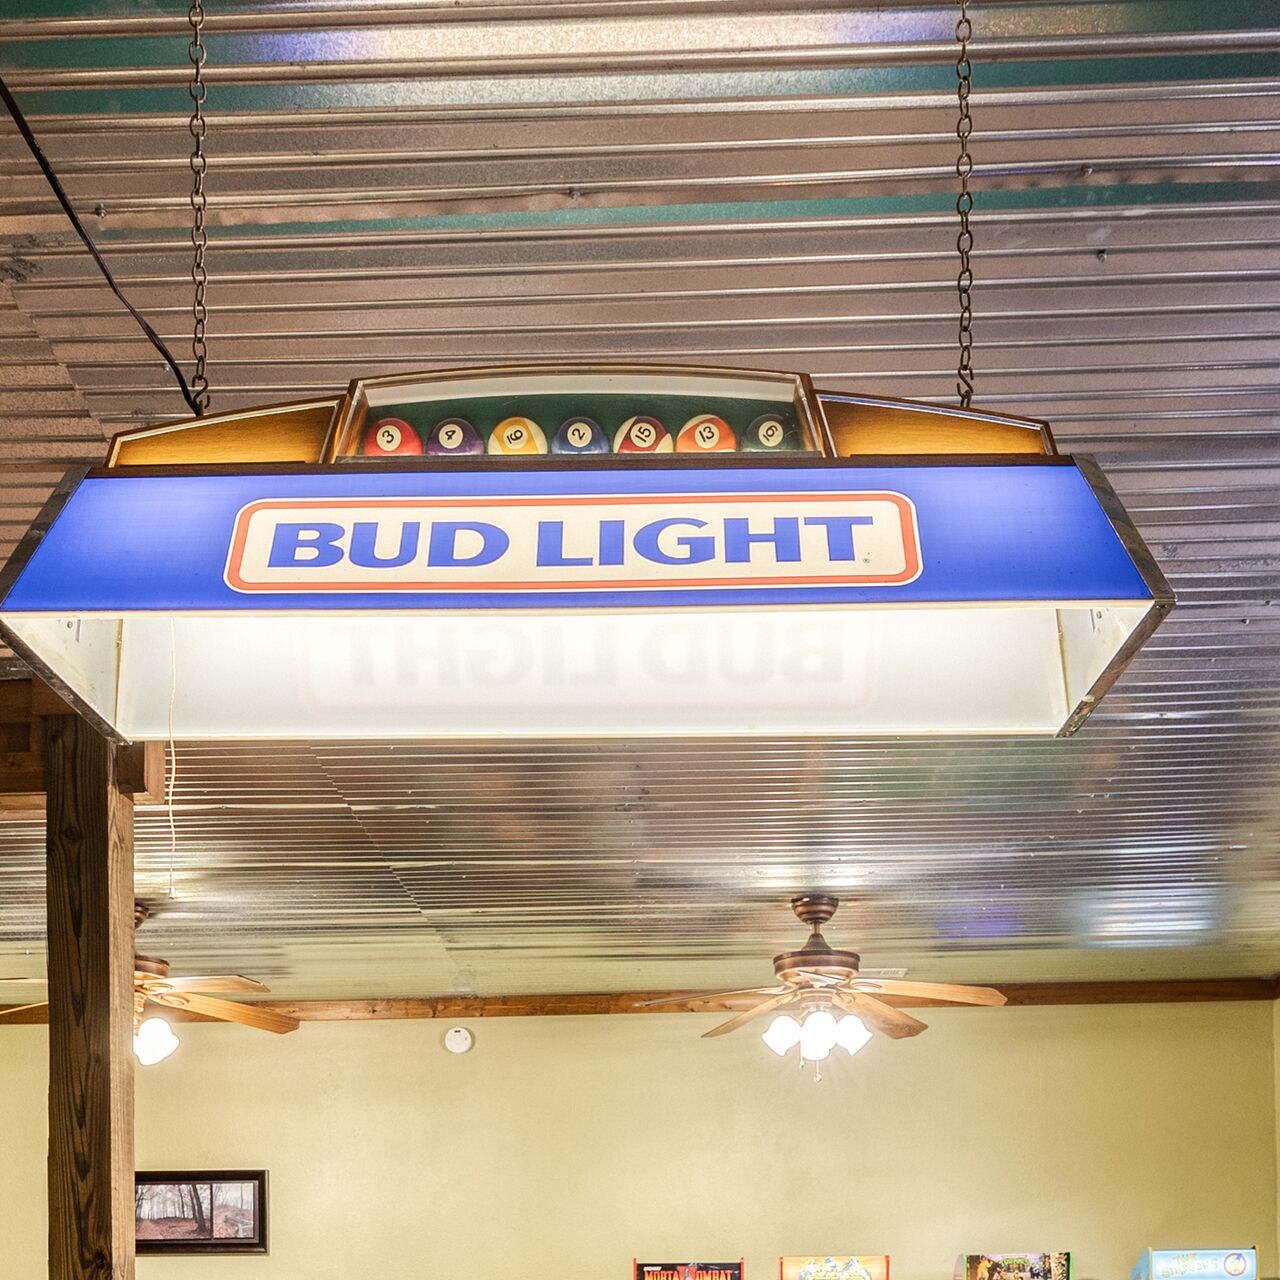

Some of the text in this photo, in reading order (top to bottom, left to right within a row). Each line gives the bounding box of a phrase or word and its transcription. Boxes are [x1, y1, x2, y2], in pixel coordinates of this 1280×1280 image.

[382, 429, 395, 443] 3
[445, 429, 457, 441] 4
[571, 428, 586, 441] 2
[635, 426, 652, 442] 15
[699, 426, 715, 442] 13
[267, 516, 874, 568] BUD LIGHT
